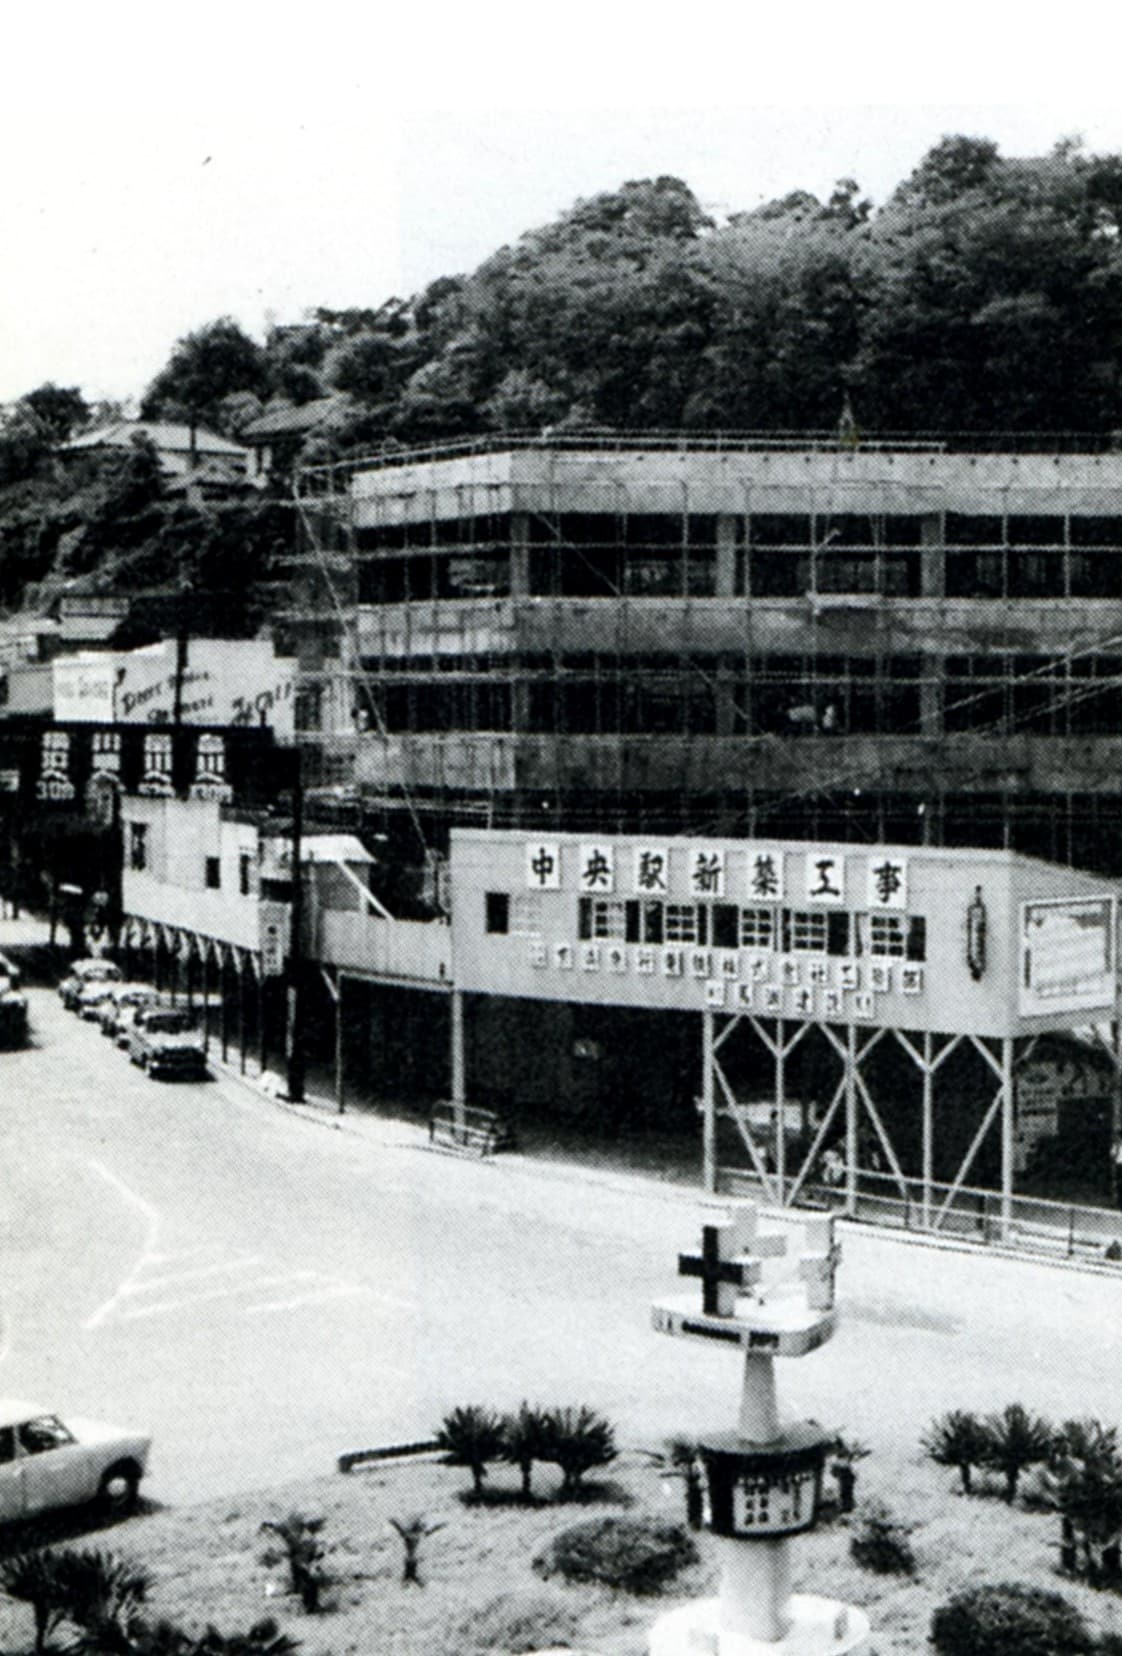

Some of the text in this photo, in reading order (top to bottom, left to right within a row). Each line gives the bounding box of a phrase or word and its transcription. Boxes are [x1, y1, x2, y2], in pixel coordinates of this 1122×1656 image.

[530, 845, 907, 905] 中央駅新築工事
